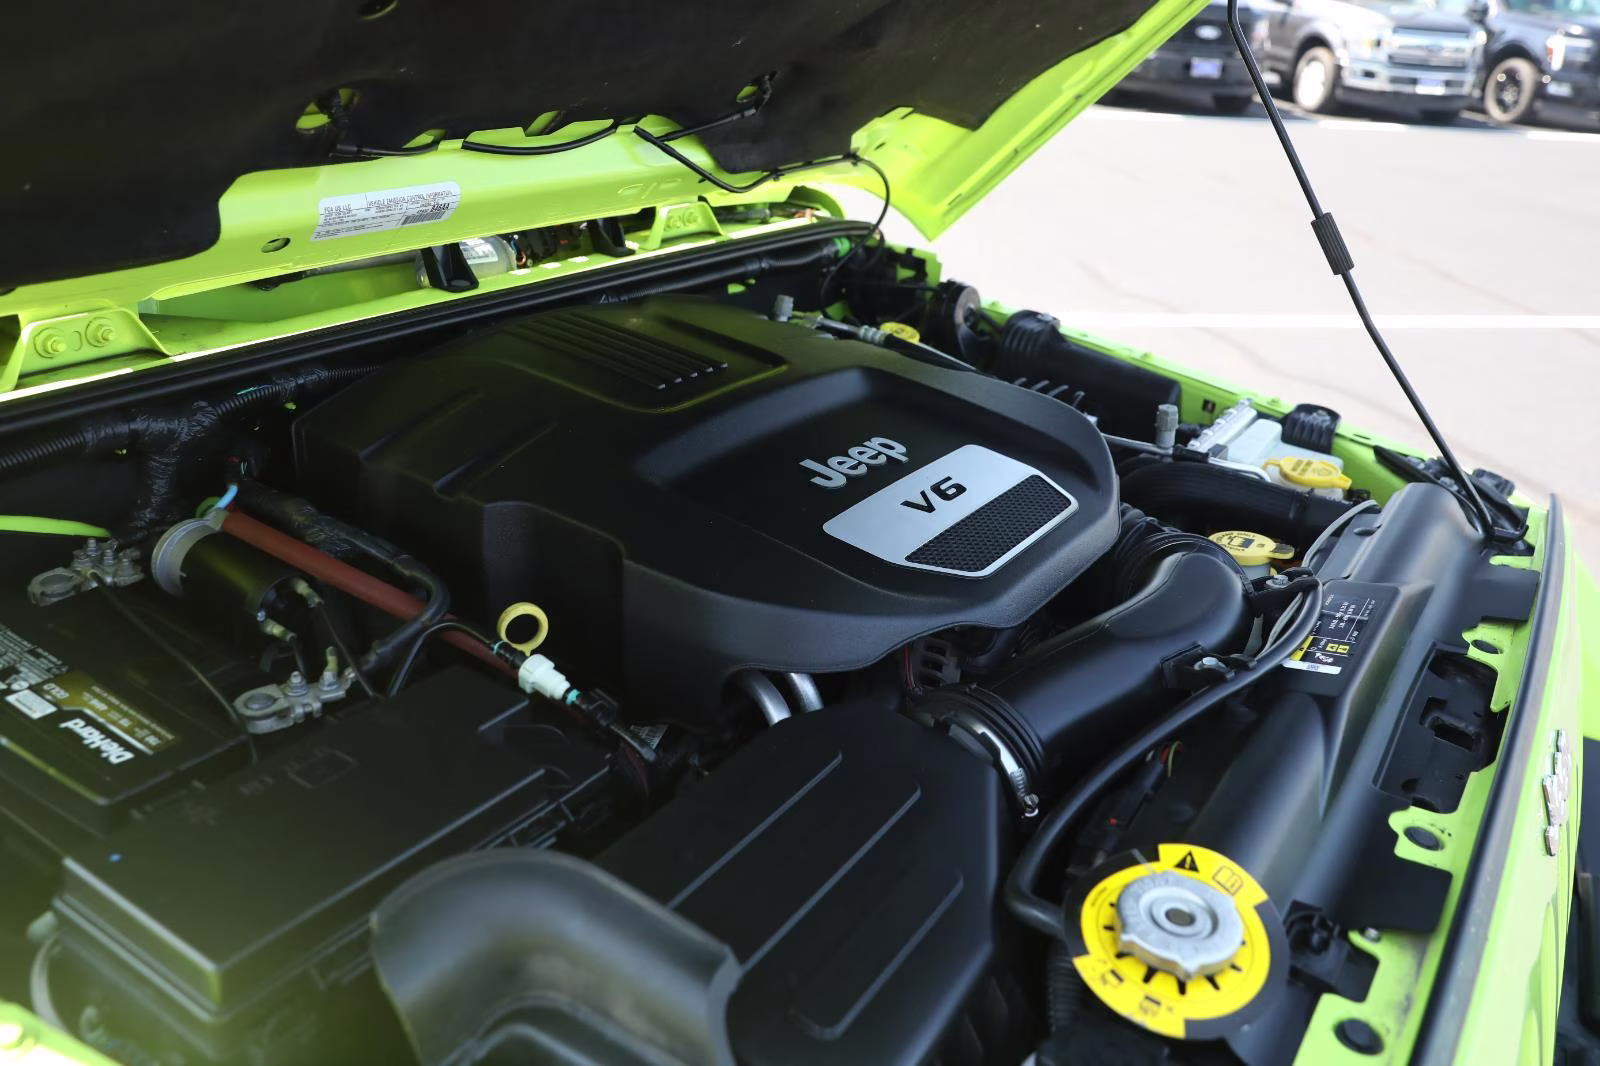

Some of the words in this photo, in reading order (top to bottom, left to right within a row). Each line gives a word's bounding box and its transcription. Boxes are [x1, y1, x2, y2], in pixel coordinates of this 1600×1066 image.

[799, 436, 909, 489] Jeep
[900, 476, 967, 514] V6
[59, 718, 135, 764] DieHard
